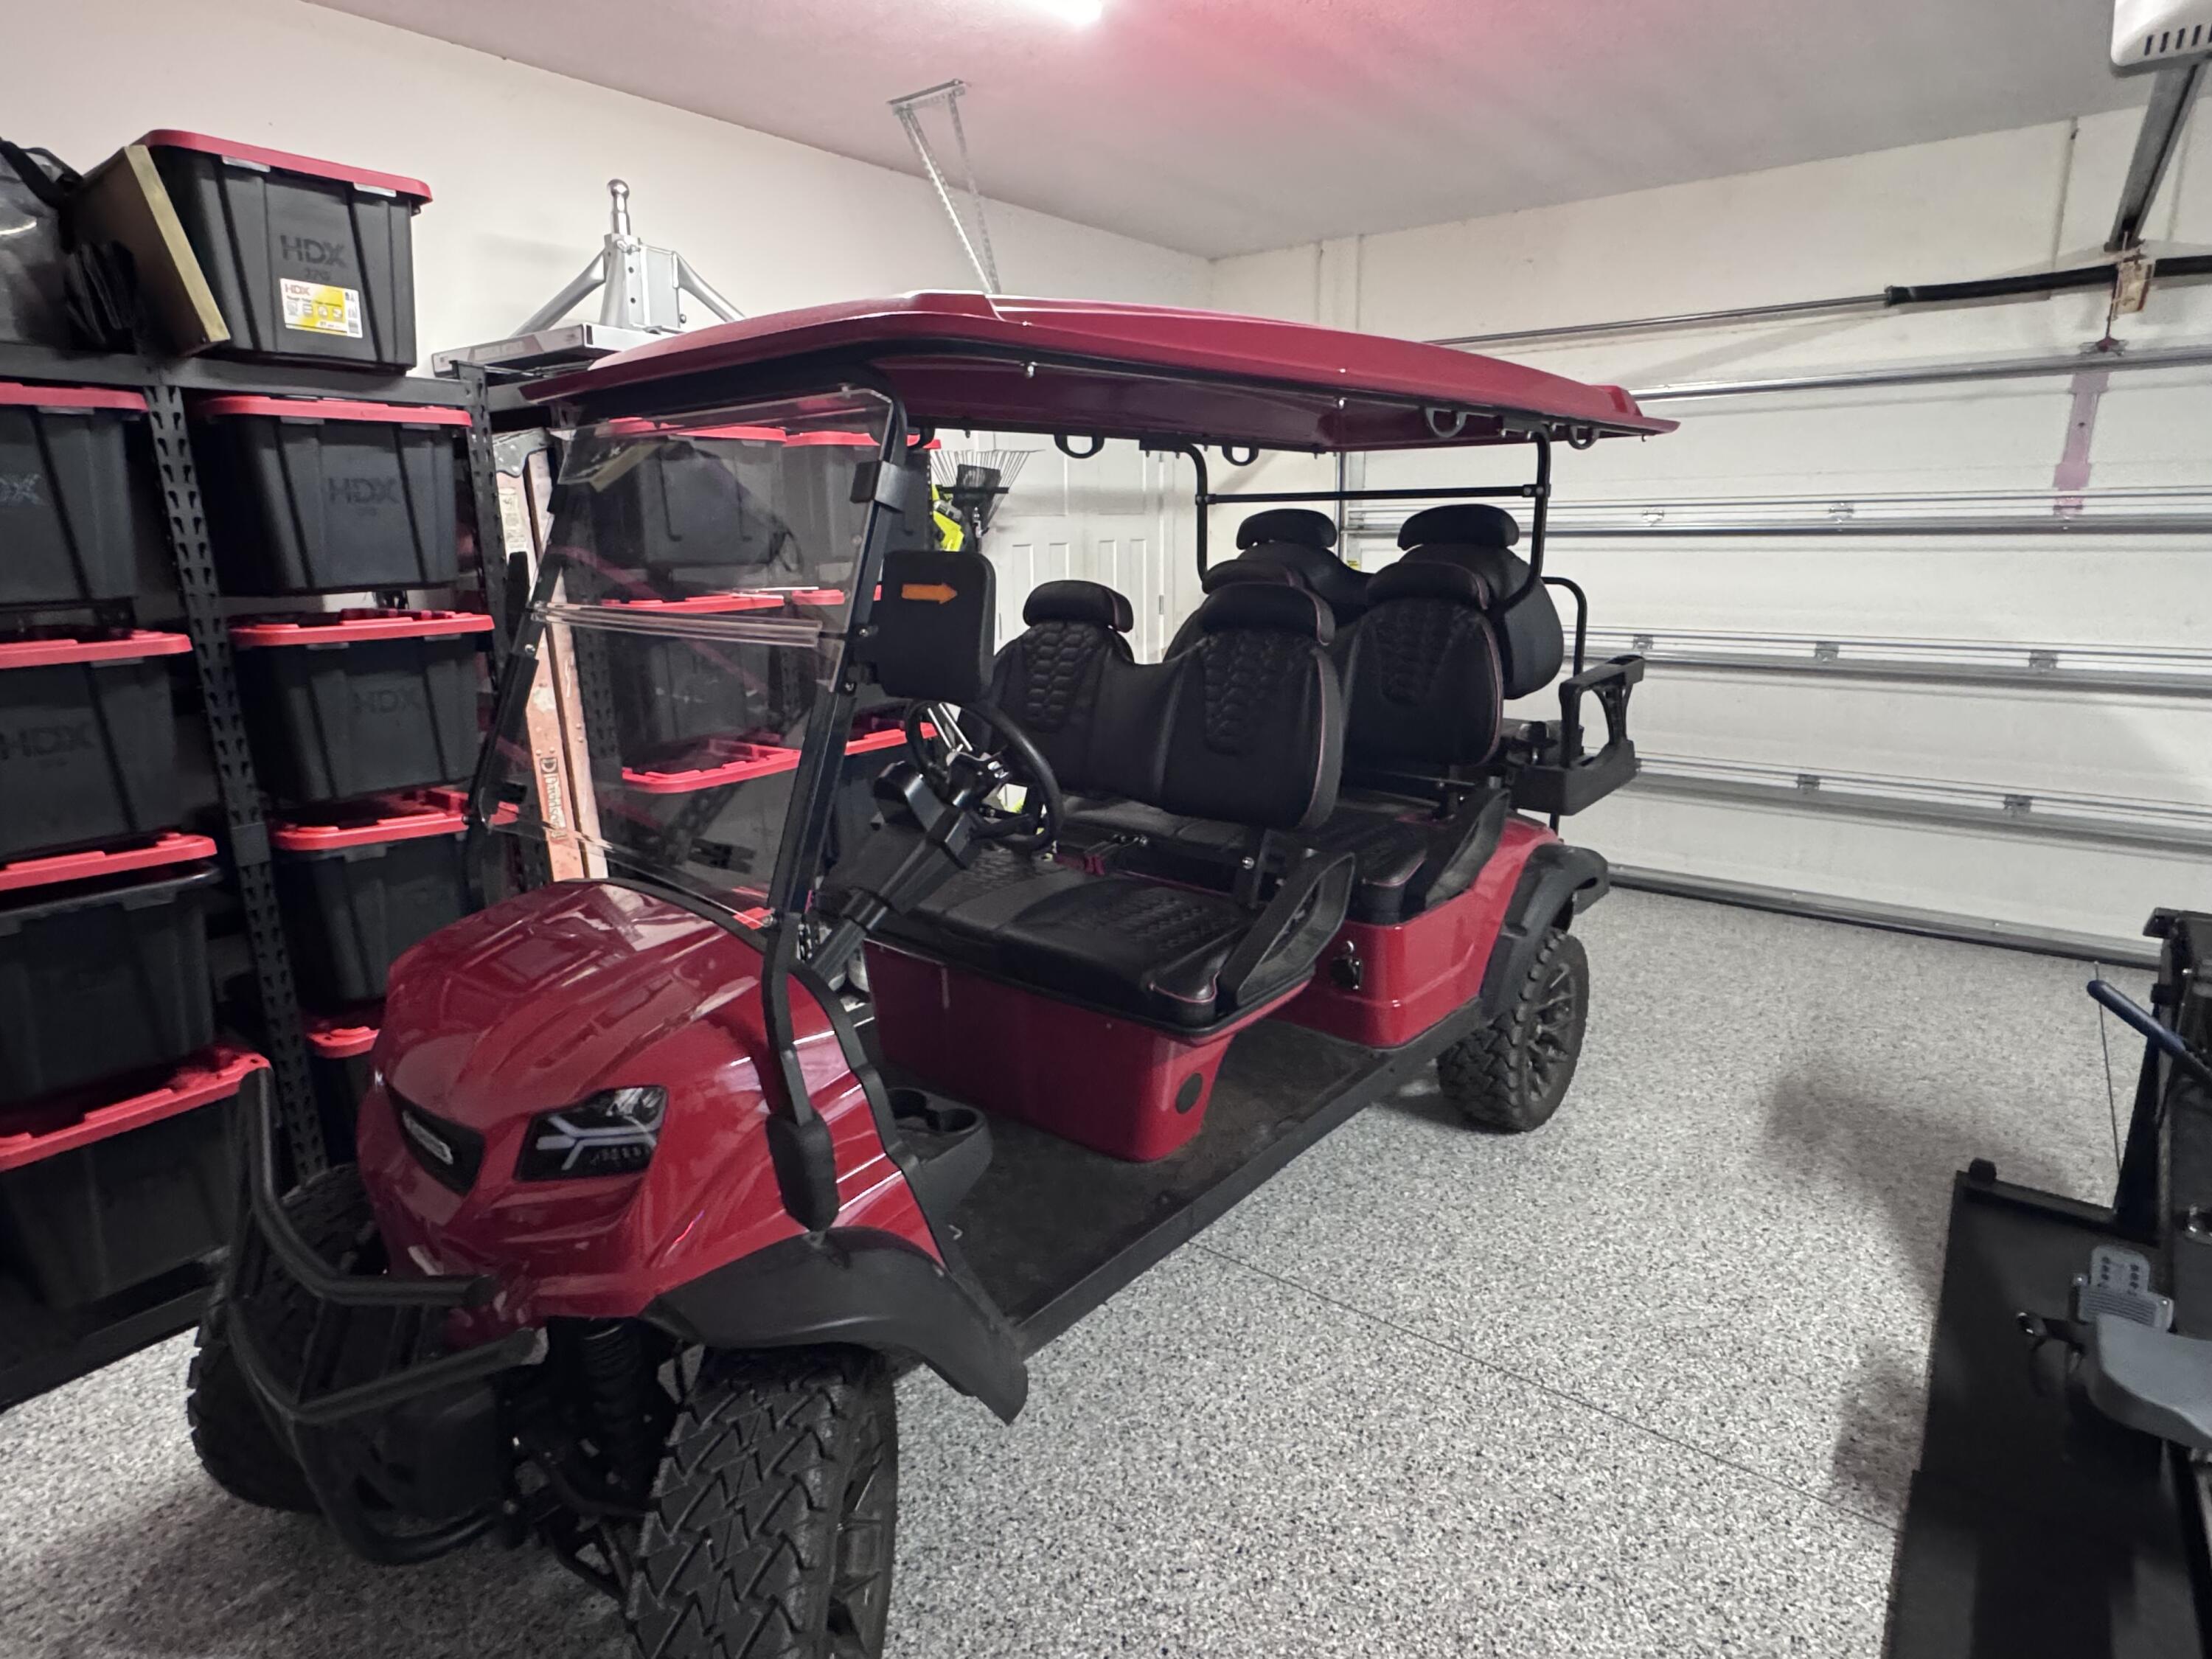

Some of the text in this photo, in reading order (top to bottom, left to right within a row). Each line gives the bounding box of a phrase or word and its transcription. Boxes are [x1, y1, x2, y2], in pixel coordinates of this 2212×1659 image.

[279, 234, 348, 268] HDX
[285, 283, 310, 296] HDX
[327, 477, 400, 504] HDX
[352, 686, 420, 714] HDX
[0, 720, 94, 759] HDX
